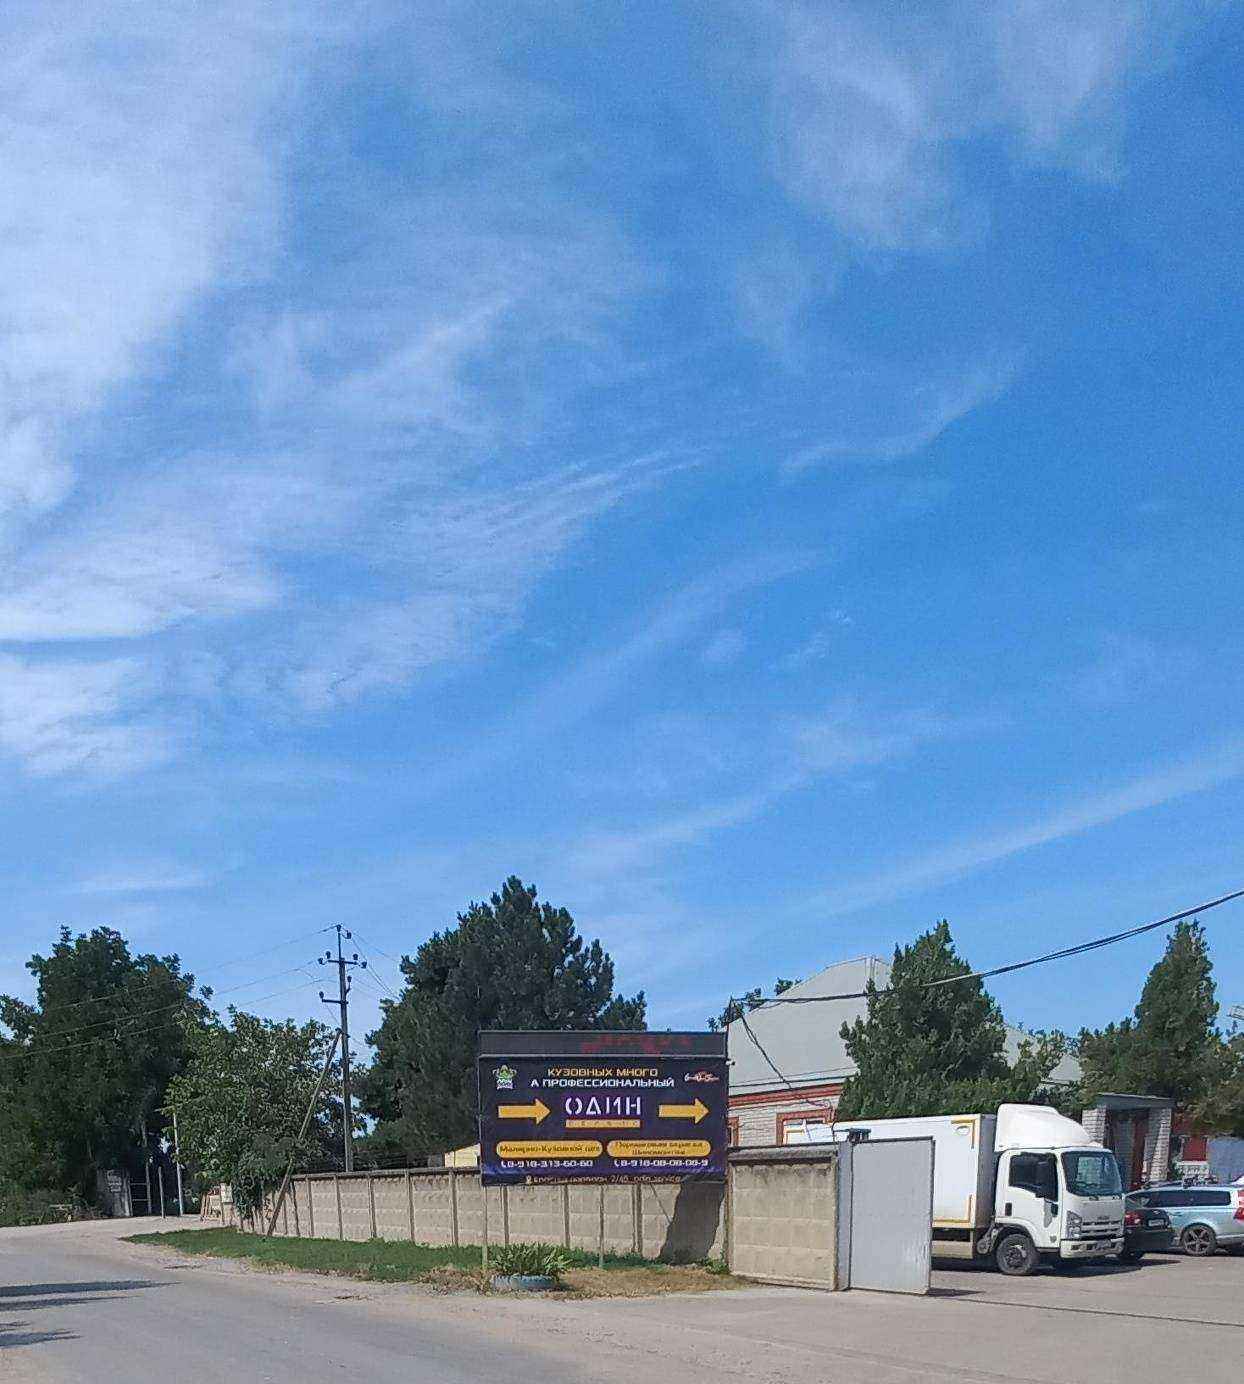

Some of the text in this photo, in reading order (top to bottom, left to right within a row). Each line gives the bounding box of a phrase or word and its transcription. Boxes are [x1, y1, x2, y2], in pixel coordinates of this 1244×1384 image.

[547, 1067, 658, 1077] КУЗОВНЫХ МНОГО
[530, 1079, 540, 1088] А
[542, 1077, 675, 1088] ПРОФЕССИОНАЛЬНЫЙ
[565, 1096, 641, 1116] ОДИН
